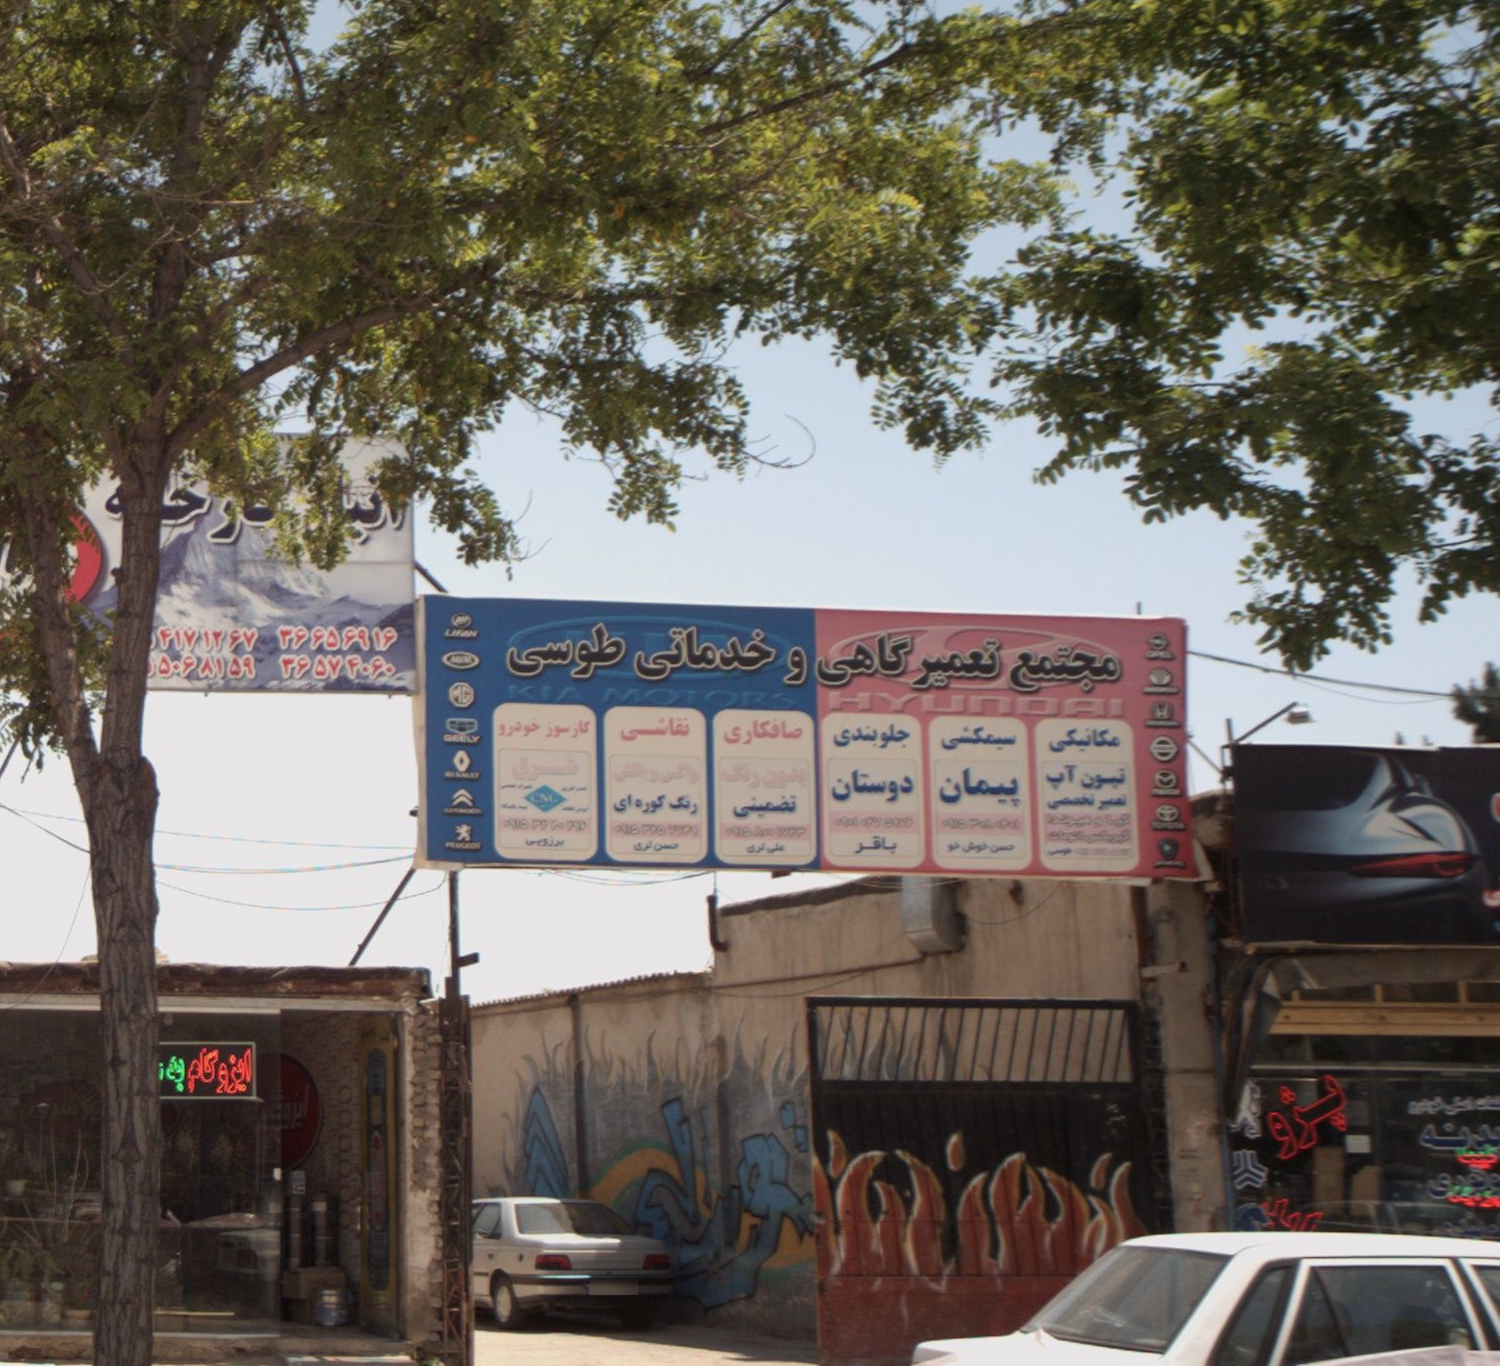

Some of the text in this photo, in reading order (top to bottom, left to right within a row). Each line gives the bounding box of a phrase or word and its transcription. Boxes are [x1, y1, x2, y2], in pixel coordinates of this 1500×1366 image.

[507, 623, 627, 679] طوسی
[634, 625, 776, 680] خدماتی
[784, 644, 808, 684] و
[1007, 644, 1120, 692] مجتمع
[829, 691, 1126, 718] HYUNDAI
[620, 717, 690, 742] نقاشی
[723, 718, 803, 744] صافکاری
[1049, 727, 1120, 752] مکانیکی
[831, 769, 913, 801] دوستان
[939, 767, 1020, 807] پیمان
[733, 795, 797, 817] تضمینی
[854, 835, 897, 854] باقر
[187, 1047, 252, 1094] ایزوگام
